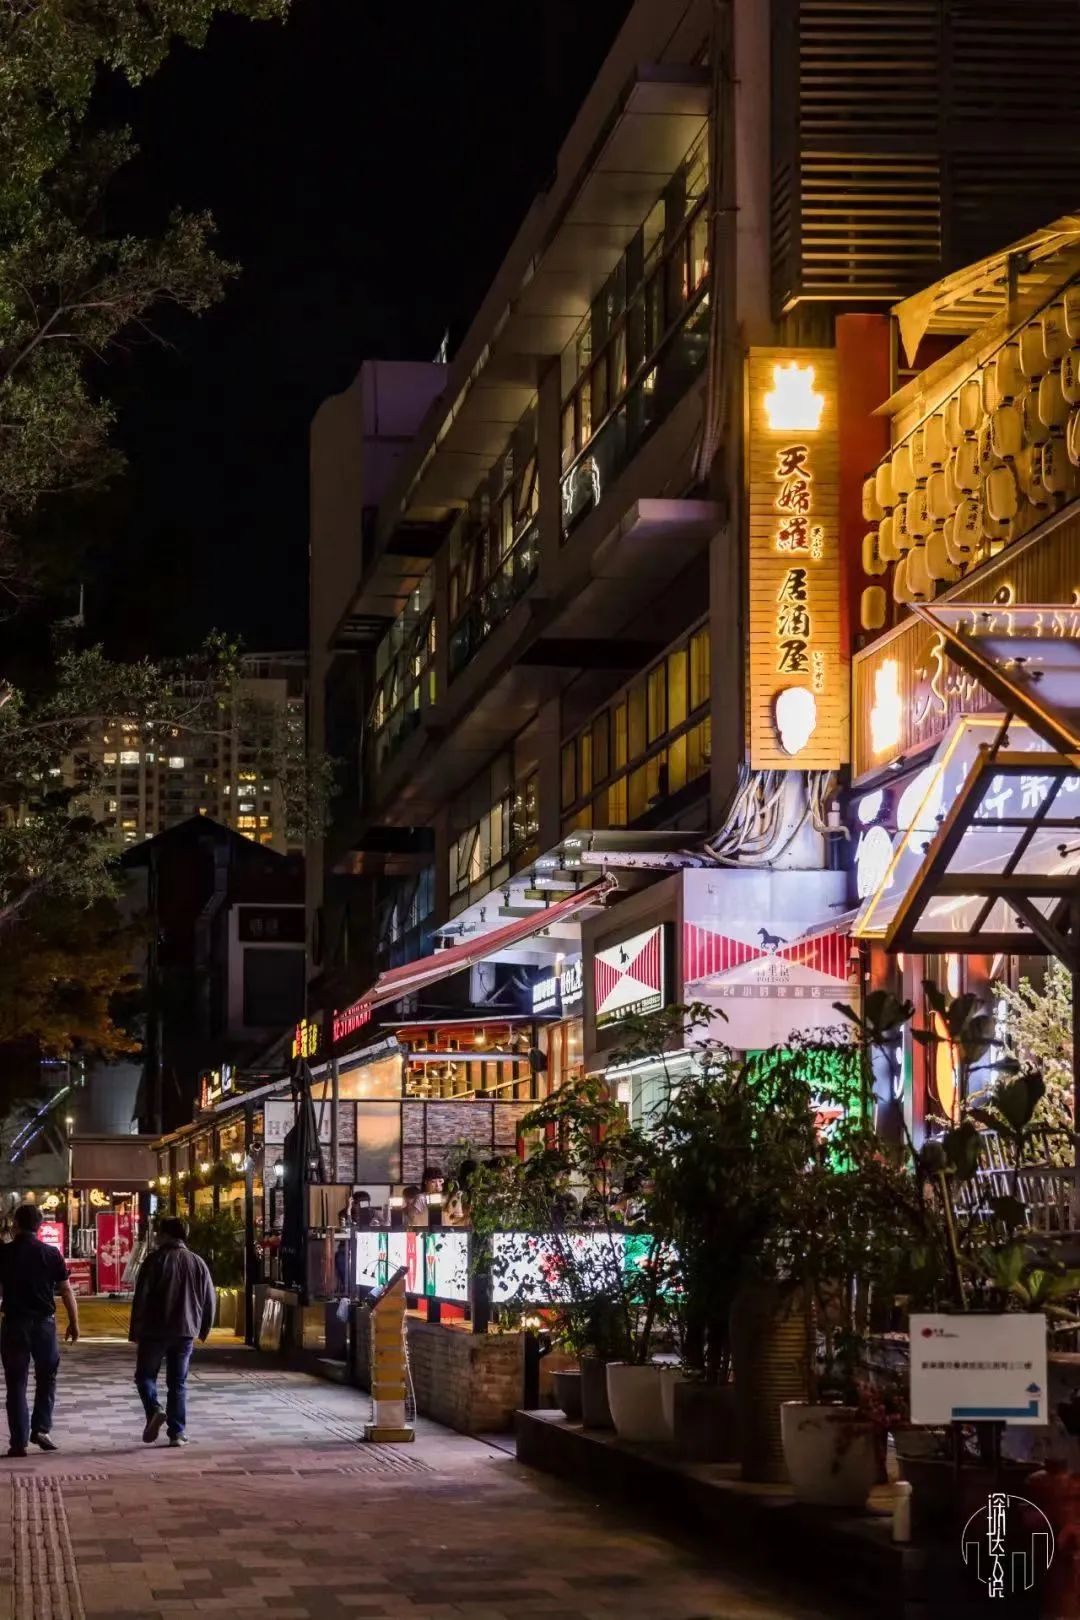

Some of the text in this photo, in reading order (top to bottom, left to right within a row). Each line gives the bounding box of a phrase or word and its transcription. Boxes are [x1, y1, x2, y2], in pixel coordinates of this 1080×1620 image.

[776, 446, 813, 673] 天婦羅 居酒屋
